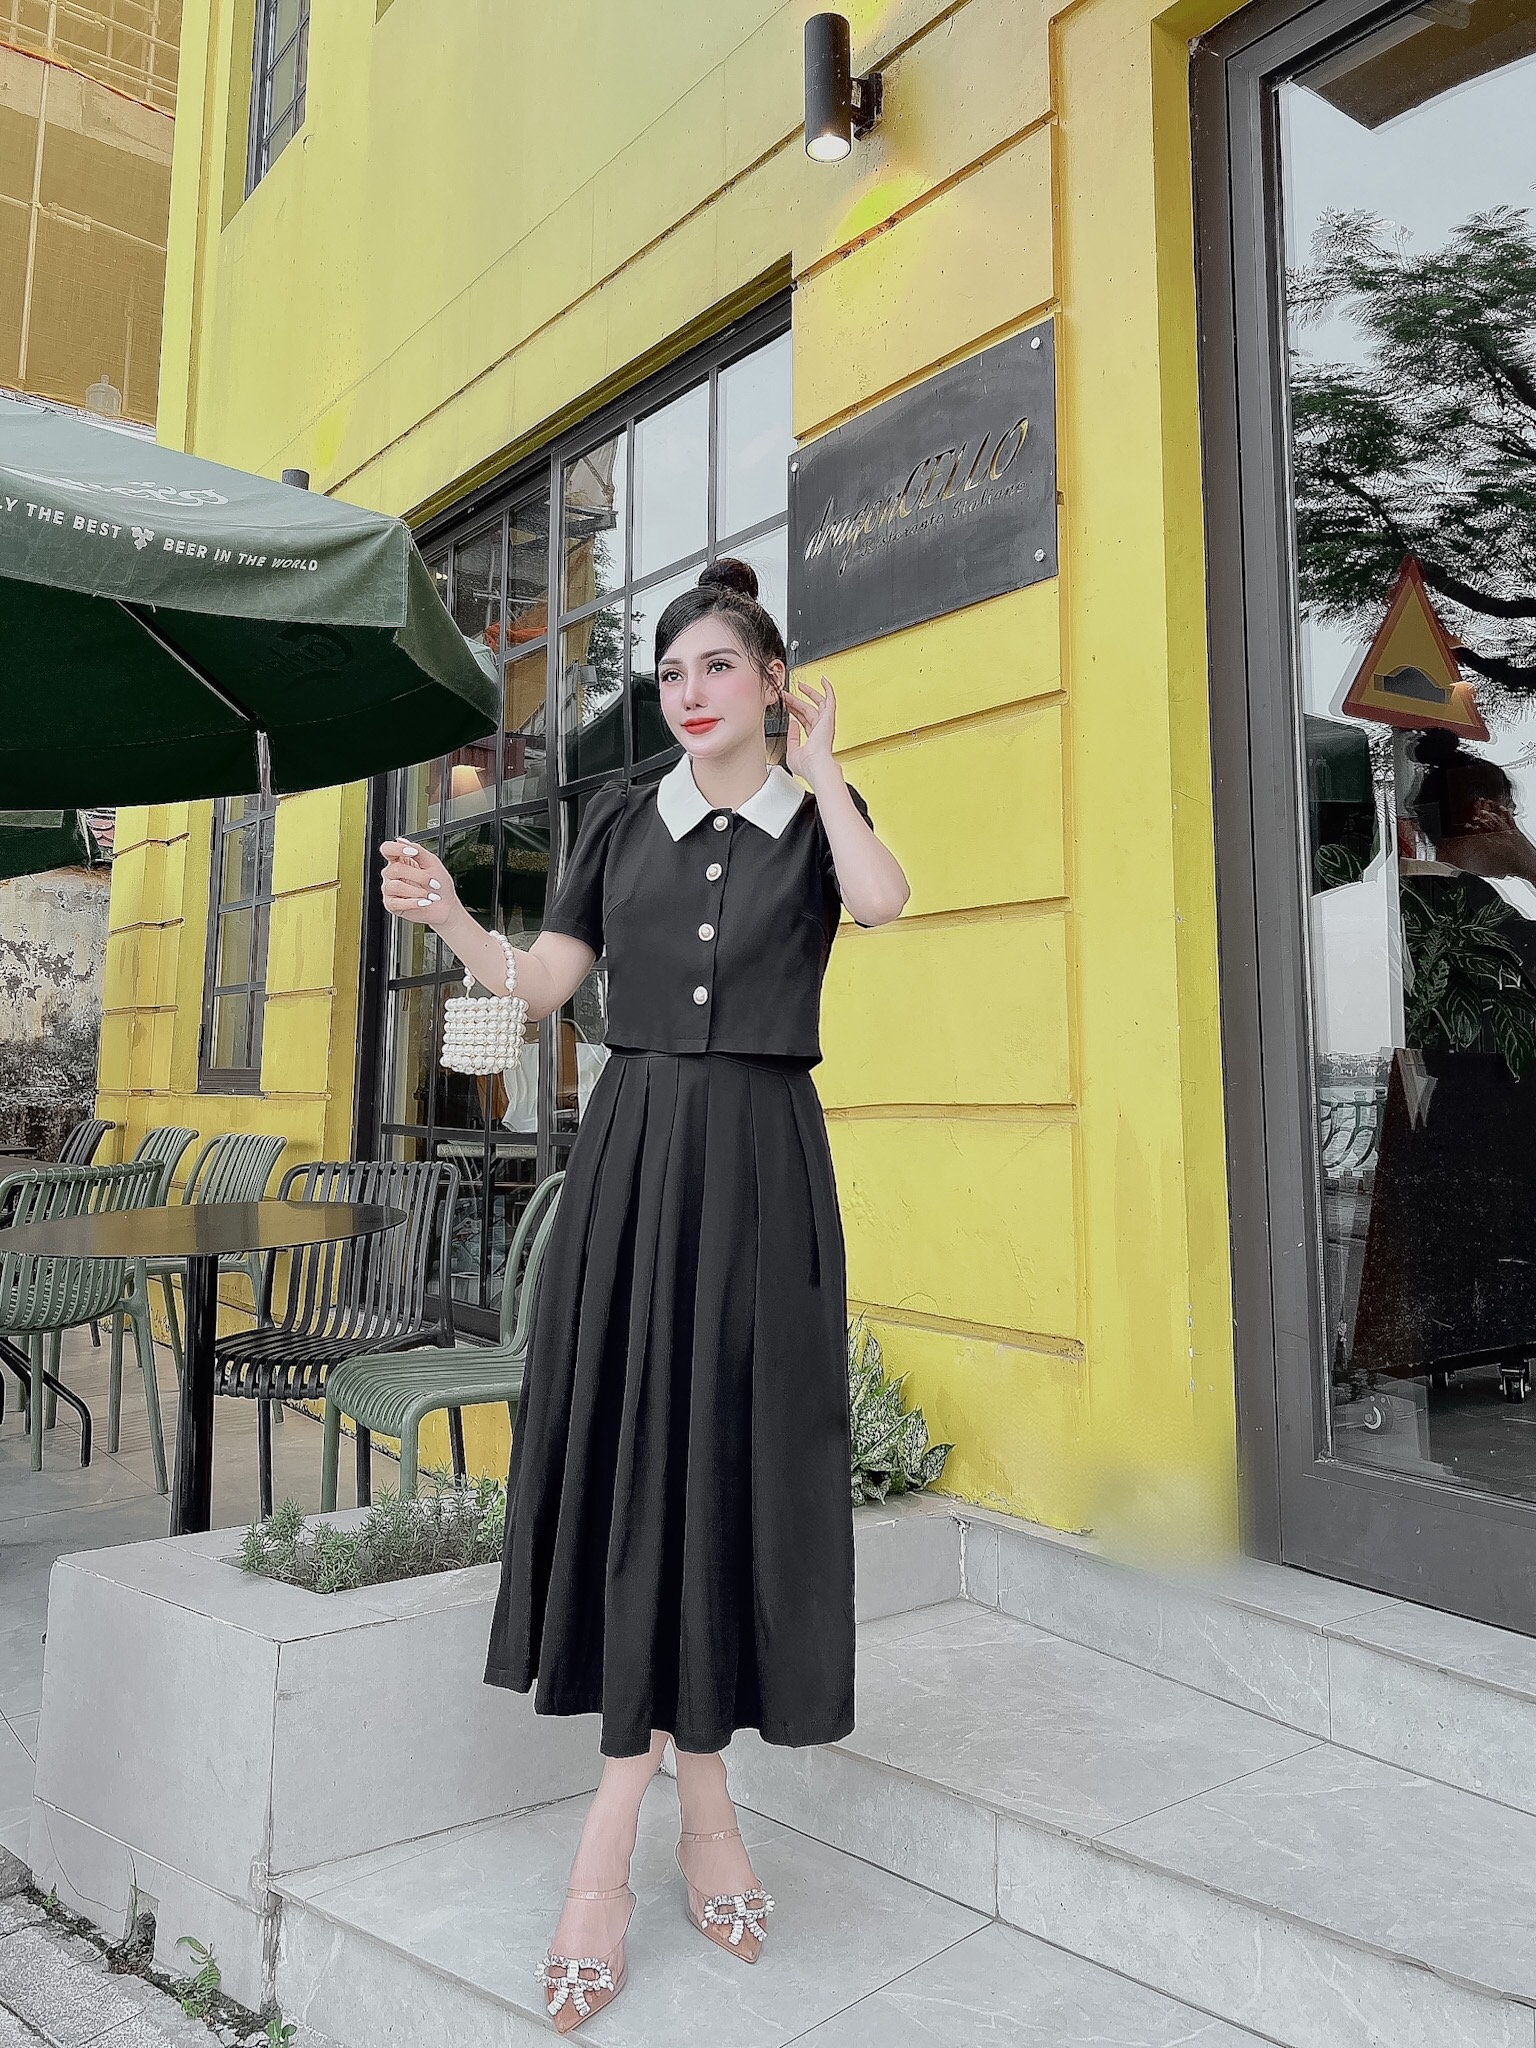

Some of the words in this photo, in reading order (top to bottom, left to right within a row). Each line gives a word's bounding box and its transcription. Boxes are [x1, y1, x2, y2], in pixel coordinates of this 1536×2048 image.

[0, 496, 19, 512] Y
[26, 502, 65, 525] THE
[72, 514, 122, 539] BEST
[163, 537, 208, 559] BEER
[213, 548, 232, 563] IN
[238, 552, 267, 568] THE
[271, 557, 319, 572] WORLD
[860, 512, 946, 557] Ristorante
[951, 480, 1028, 519] Italiano
